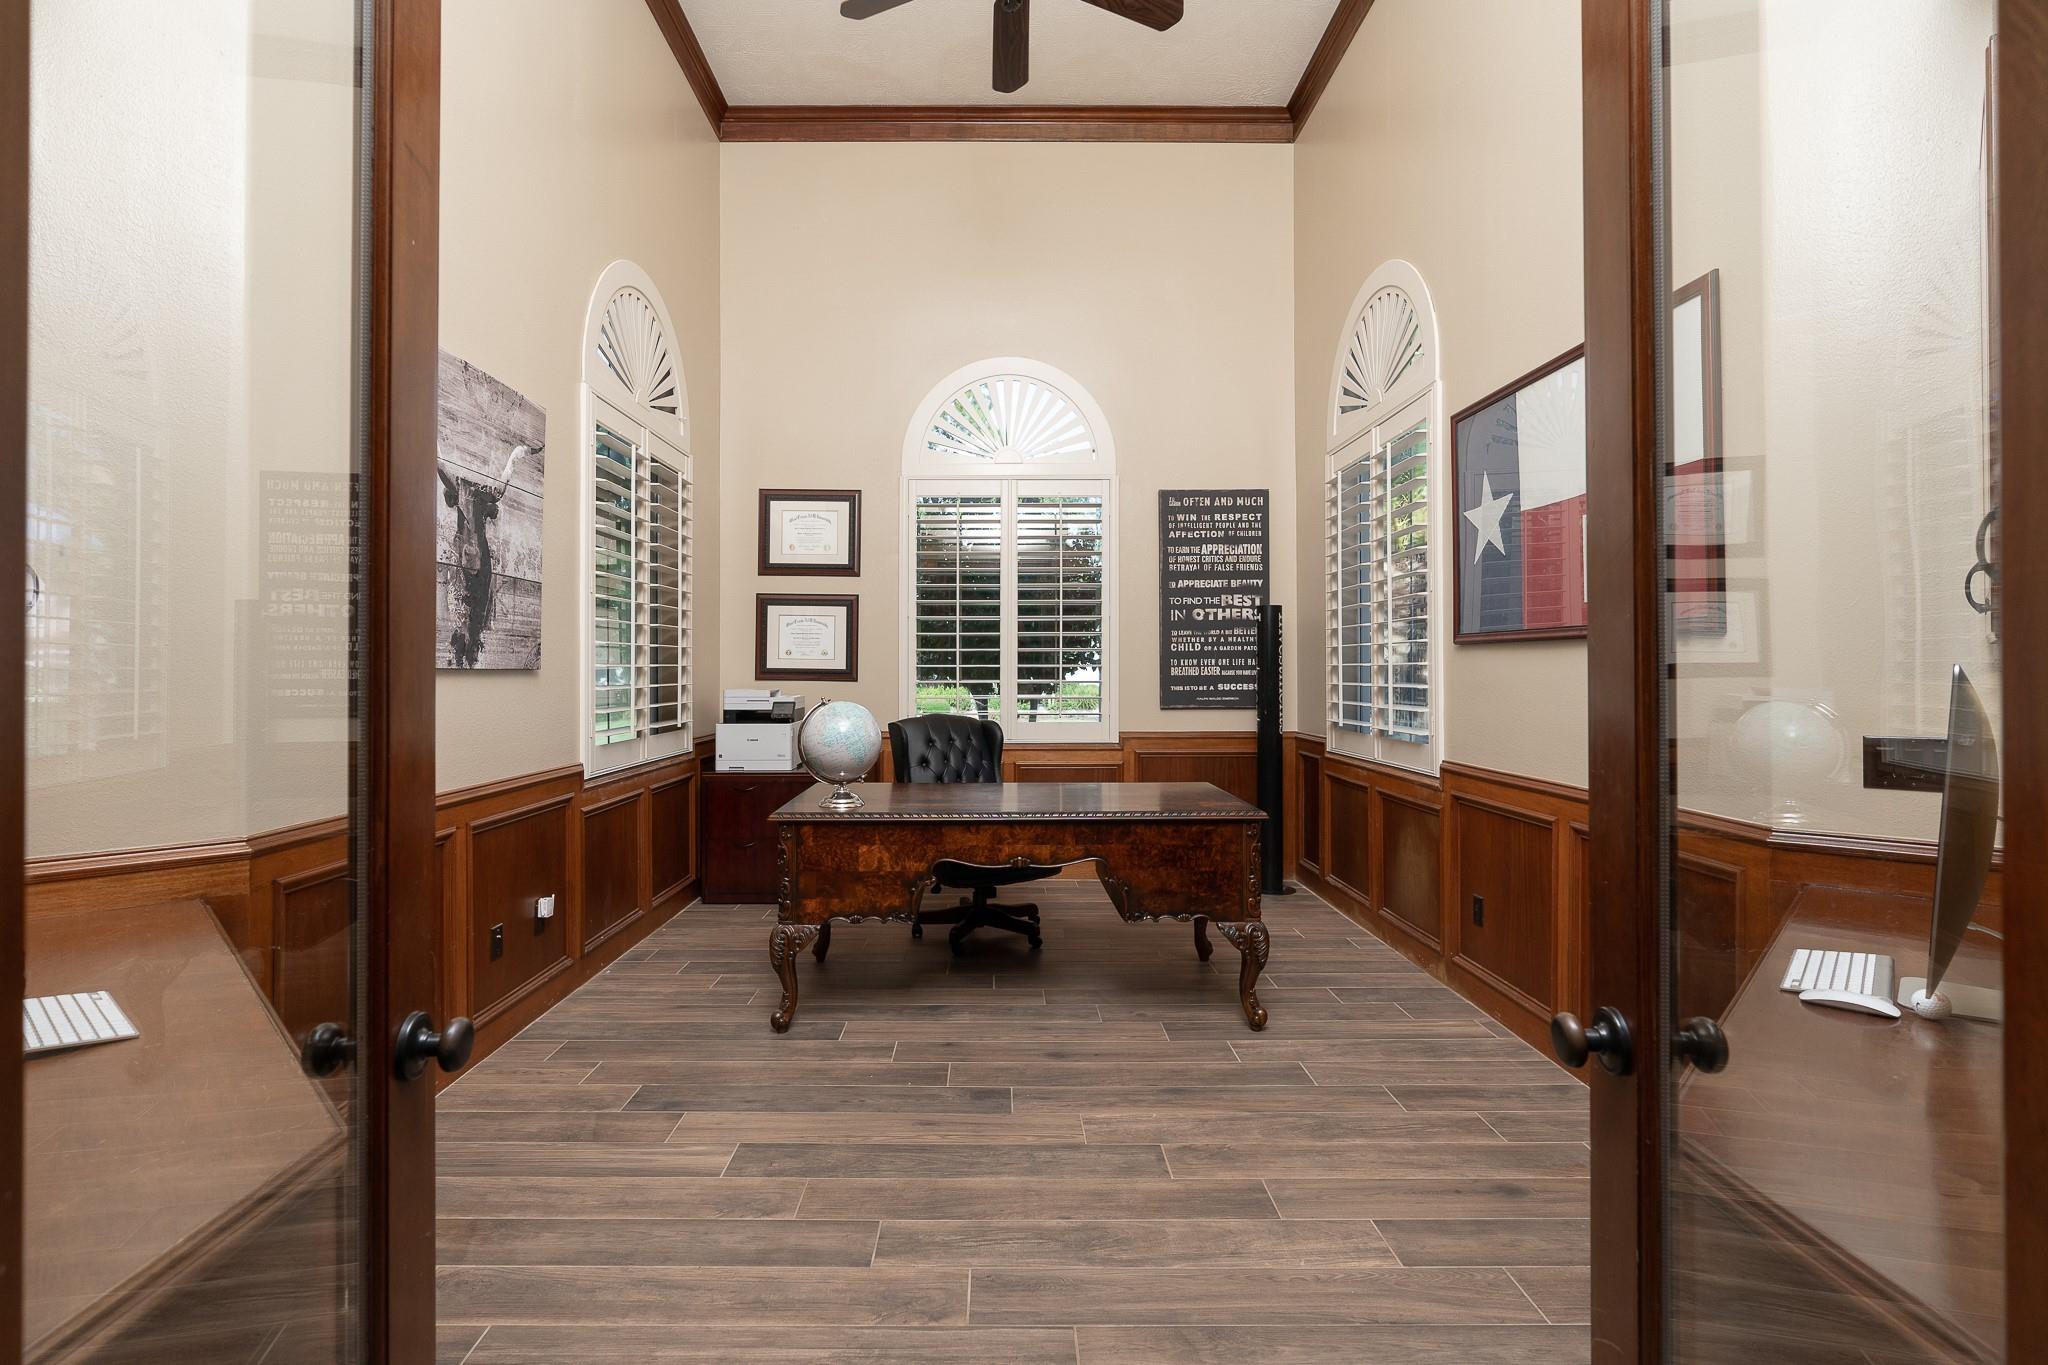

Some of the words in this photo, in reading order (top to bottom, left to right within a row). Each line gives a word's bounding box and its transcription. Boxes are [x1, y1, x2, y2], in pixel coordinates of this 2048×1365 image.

[1183, 497, 1210, 506] OFTEN
[1214, 497, 1233, 506] AND
[1236, 497, 1264, 506] MUCH
[1201, 544, 1262, 554] APPRECIATION
[1178, 580, 1228, 588] APPRECIATE
[1221, 594, 1263, 606] BEST
[1170, 609, 1186, 621] IN
[1170, 643, 1201, 651] CHILD
[1170, 667, 1199, 676] BREATHED
[1200, 667, 1220, 676] EASIER
